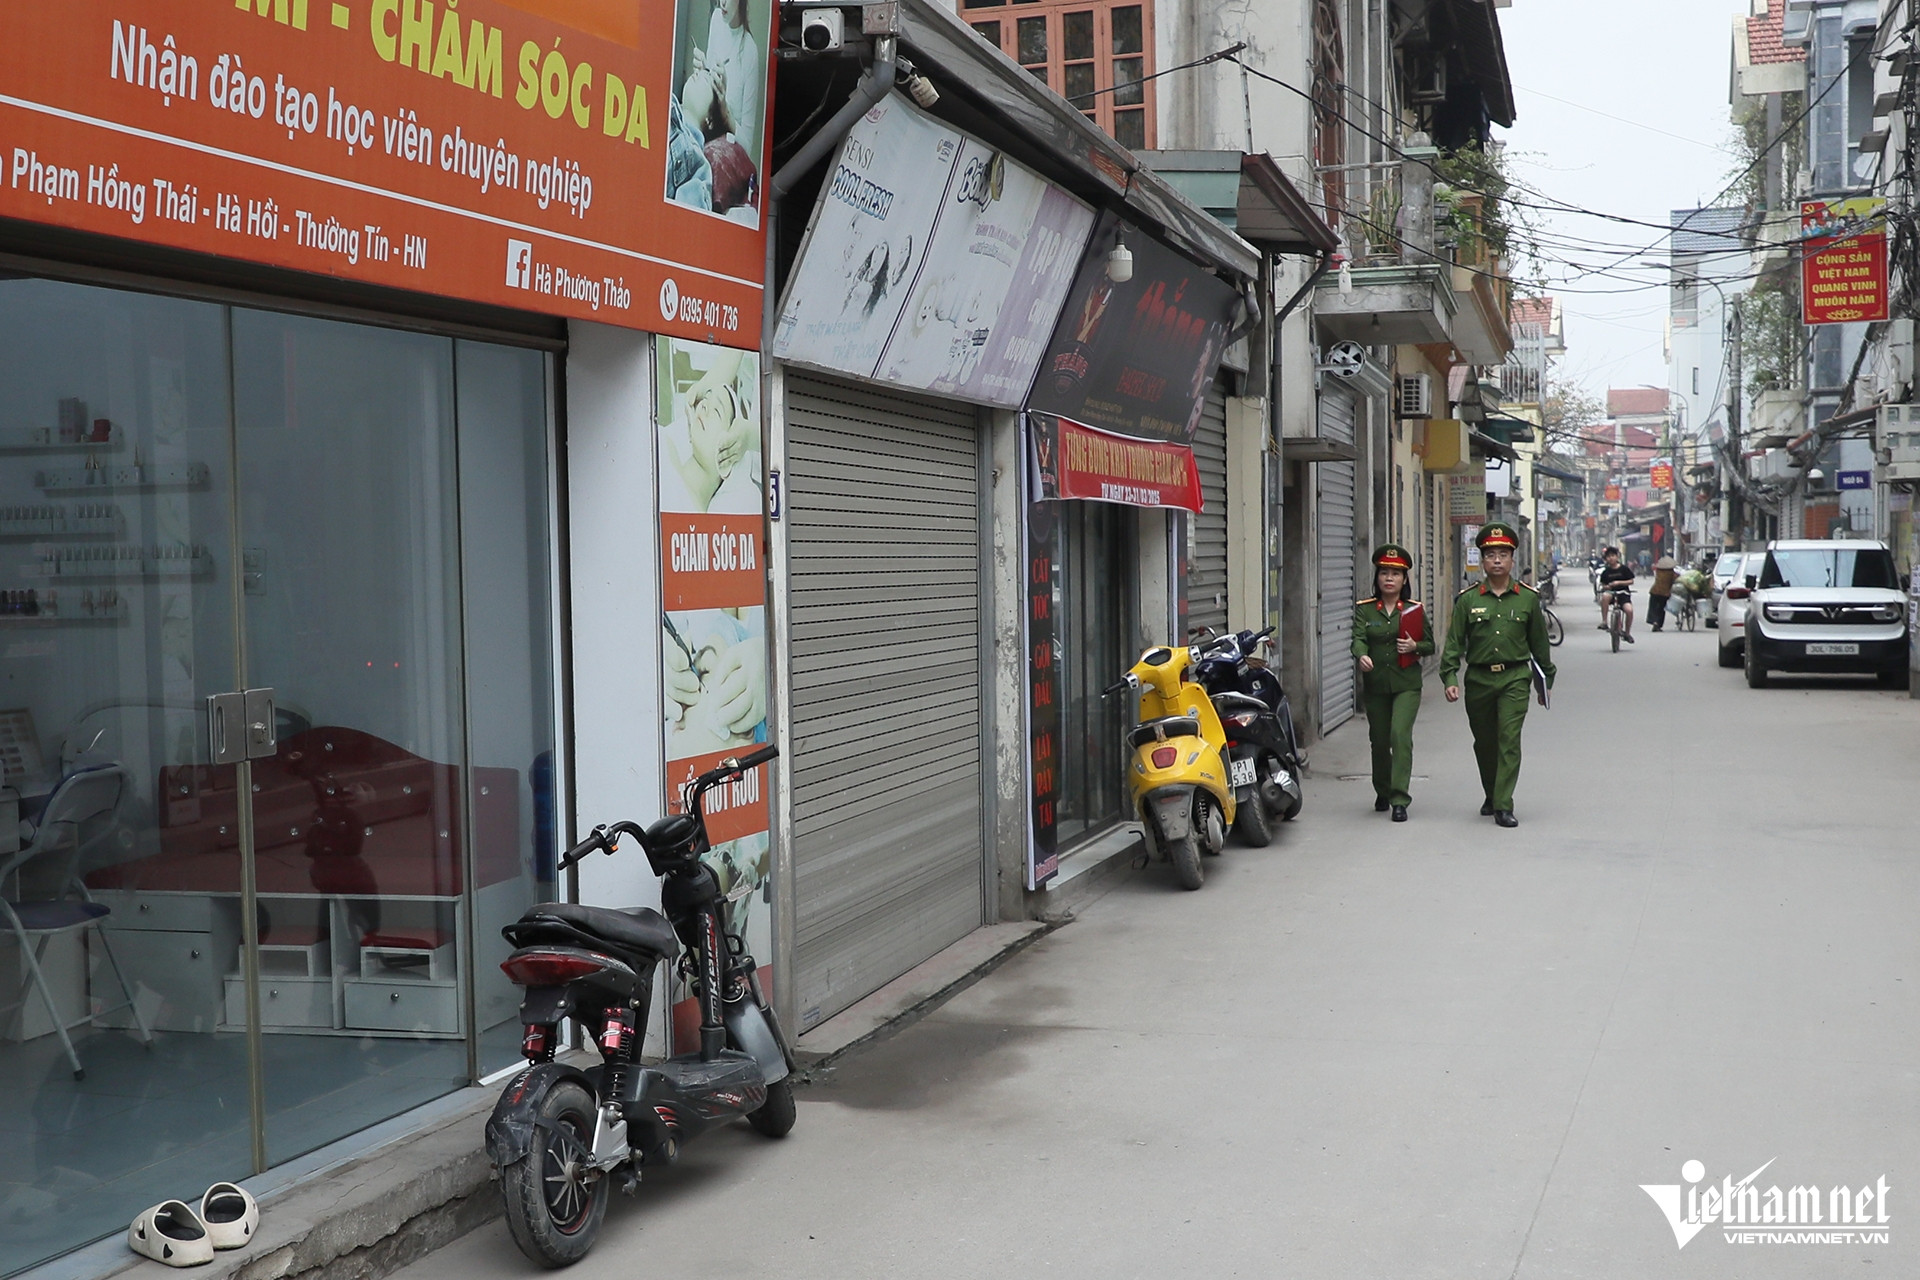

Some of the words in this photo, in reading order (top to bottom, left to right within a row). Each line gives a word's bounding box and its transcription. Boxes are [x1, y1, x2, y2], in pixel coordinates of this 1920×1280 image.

[516, 37, 592, 128] SÓC
[603, 73, 649, 150] DA
[111, 19, 198, 106] Nhận
[209, 53, 266, 118] đào
[275, 73, 318, 139] tạo
[326, 86, 375, 155] học
[383, 107, 432, 166] viên
[440, 126, 518, 194] chuyên
[526, 156, 592, 219] nghiệp
[12, 148, 79, 205] Phạm
[87, 163, 146, 224] Hồng
[153, 179, 198, 224] Thái
[202, 207, 210, 216] -
[216, 193, 241, 233] Hà
[247, 197, 278, 240] Hồi
[283, 223, 290, 232] -
[295, 210, 359, 264] Thường
[365, 225, 389, 262] Tín
[404, 235, 427, 270] HN
[859, 180, 894, 221] FRESH
[1816, 253, 1846, 266] CỘNG
[1849, 251, 1872, 263] SẢN
[1818, 267, 1842, 280] VIỆT
[1844, 268, 1870, 278] NAM
[535, 262, 551, 296] Hà
[555, 267, 600, 310] Phương
[603, 276, 631, 310] Thảo
[1812, 282, 1848, 293] QUANG
[1852, 281, 1877, 291] VINH
[1814, 294, 1847, 307] MUÔN
[1850, 294, 1875, 304] NĂM
[680, 295, 702, 324] 0395
[704, 299, 720, 328] 401
[723, 303, 738, 331] 736
[671, 525, 709, 572] CHĂM
[713, 525, 736, 571] SÓC
[740, 534, 755, 570] DA
[1032, 551, 1049, 583] CẮT
[1032, 590, 1049, 620] TÓC
[1034, 640, 1050, 672] GỘI
[1034, 673, 1051, 708] ĐẦU
[1036, 726, 1051, 761] LẤY
[1036, 766, 1052, 797] RÁY
[1039, 801, 1053, 829] TAI
